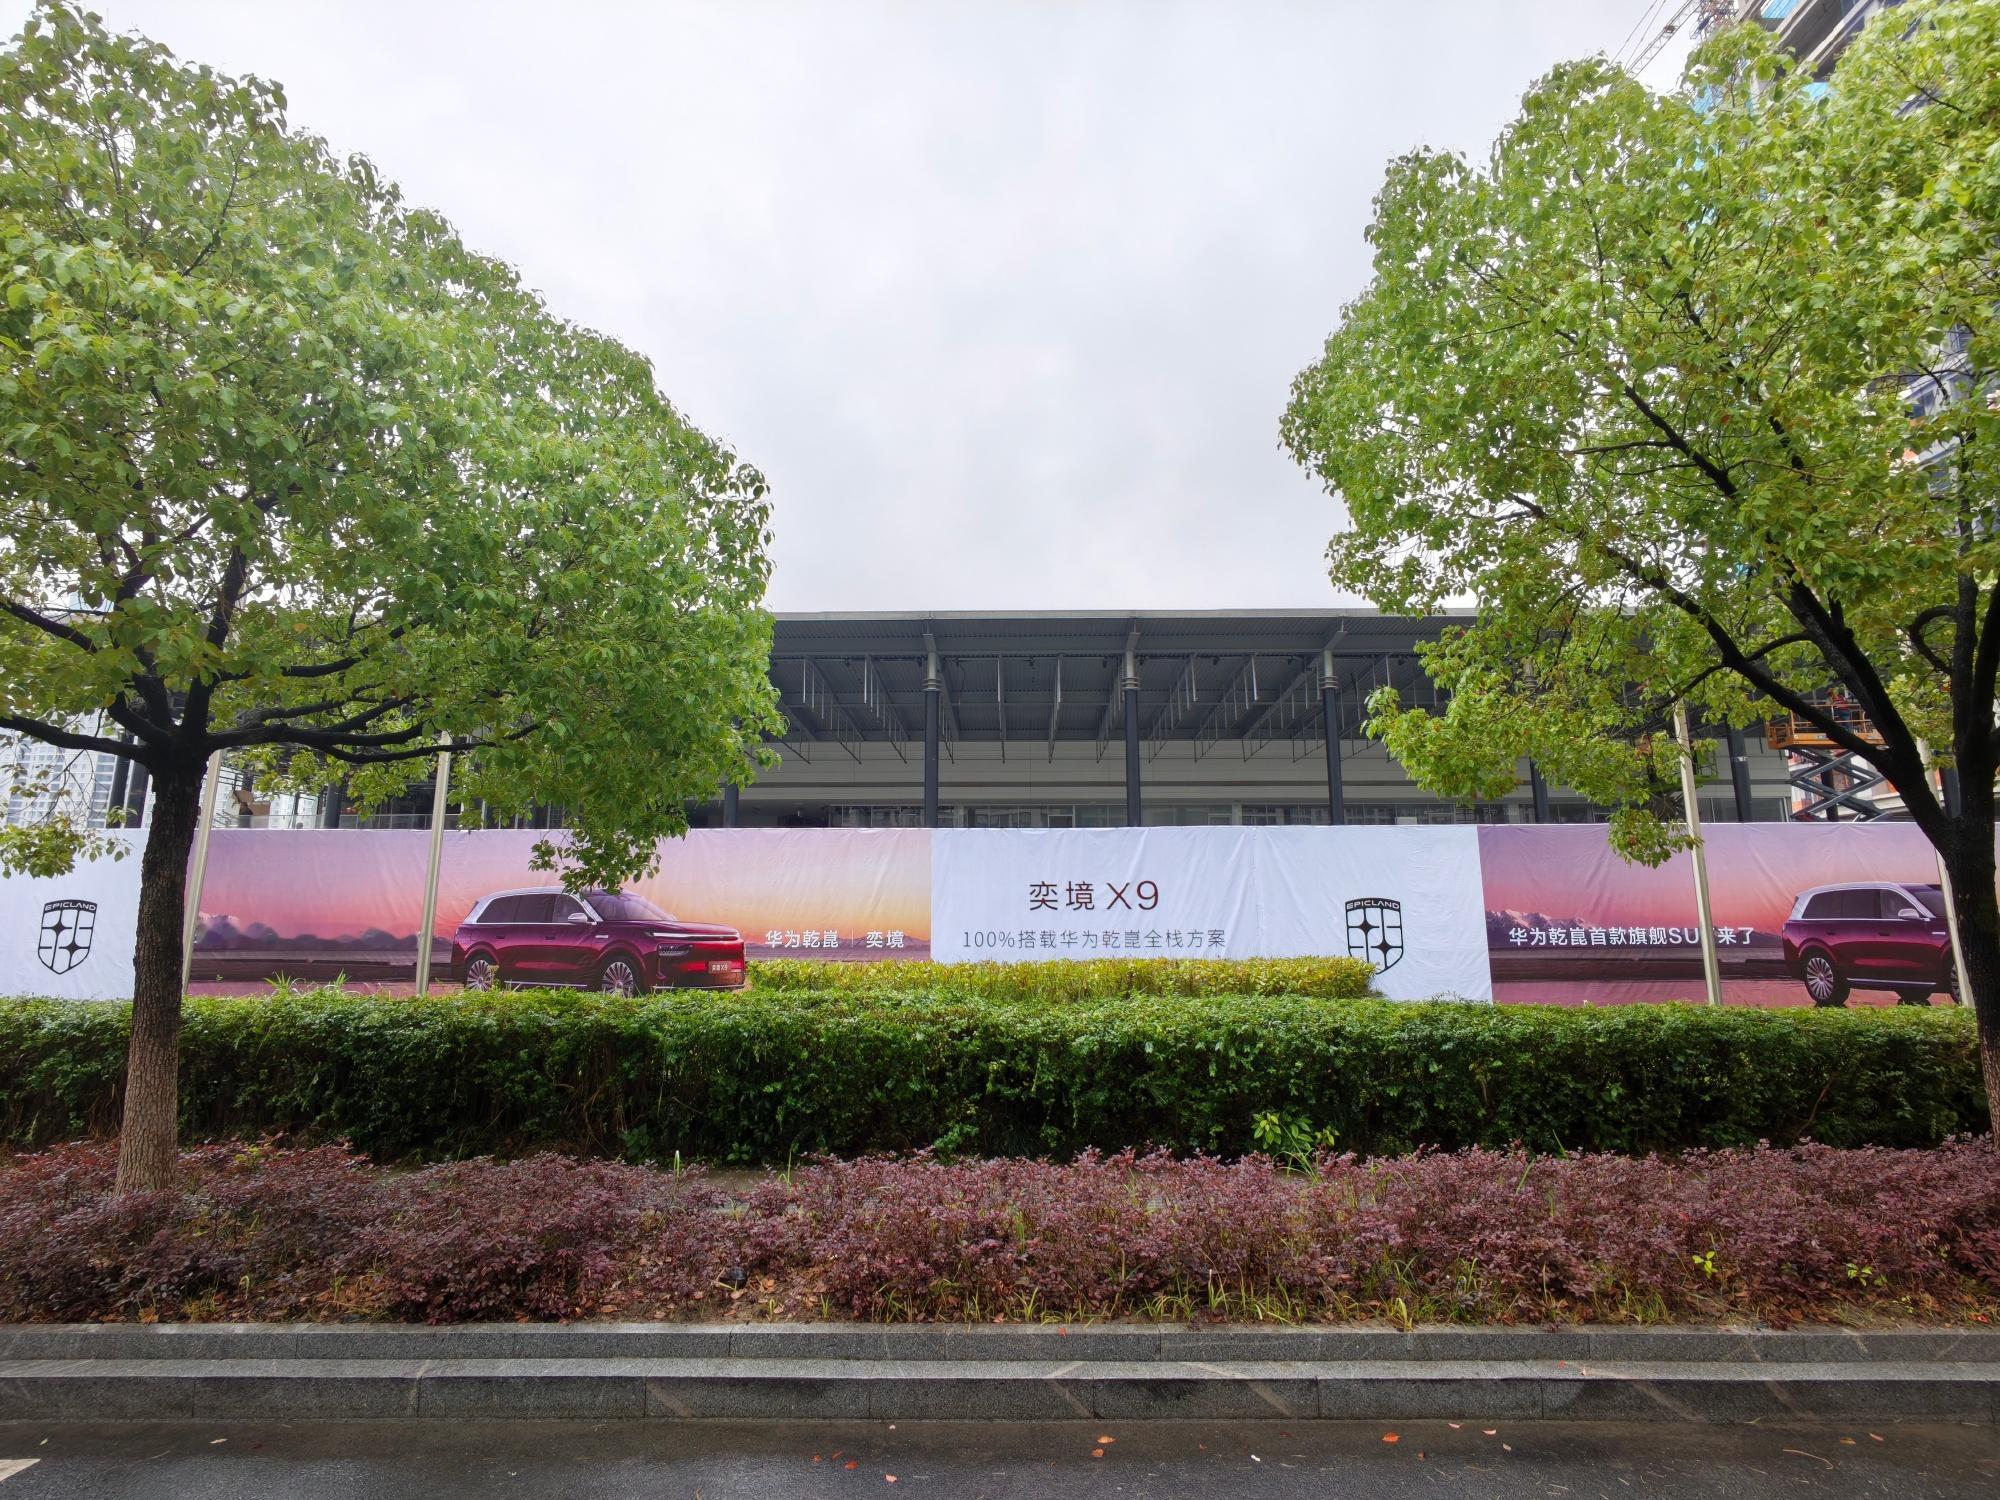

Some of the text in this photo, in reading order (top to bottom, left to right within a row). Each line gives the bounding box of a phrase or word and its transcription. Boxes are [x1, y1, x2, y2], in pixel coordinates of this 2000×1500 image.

[44, 901, 97, 911] EPICLAND
[1346, 899, 1400, 910] EPICLAND
[865, 929, 905, 949] 奕境
[1508, 925, 1755, 946] 华为乾崑首款旗舰SU来了
